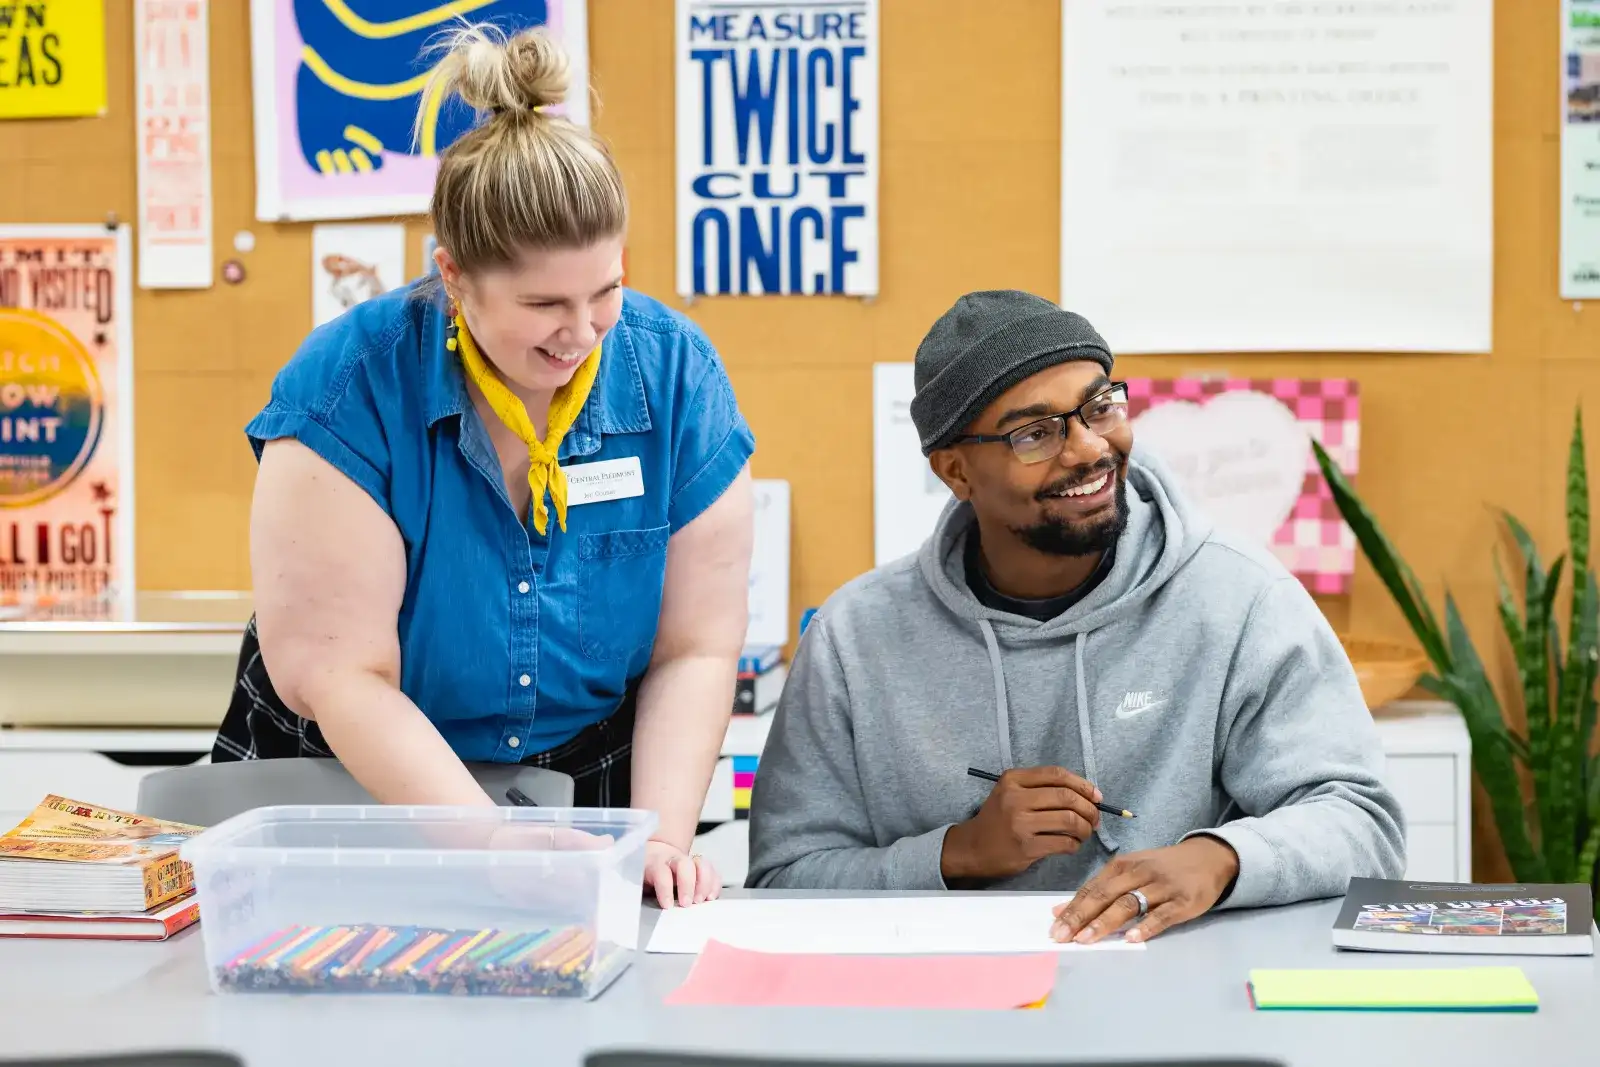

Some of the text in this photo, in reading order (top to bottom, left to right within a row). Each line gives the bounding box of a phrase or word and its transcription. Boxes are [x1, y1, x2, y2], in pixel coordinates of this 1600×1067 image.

[689, 12, 867, 42] MEASURE
[690, 46, 866, 167] TWICE
[692, 172, 865, 200] CUT
[692, 206, 865, 293] ONCE
[29, 268, 112, 324] VISITED
[1, 416, 61, 443] INT
[570, 474, 600, 484] CENTRAL
[601, 470, 636, 480] PIEDMONT
[37, 523, 50, 565] I
[61, 508, 115, 565] GOT
[1123, 691, 1153, 708] NIKE
[48, 801, 92, 818] WOOD
[1361, 902, 1439, 912] BITS
[1446, 897, 1565, 909] PAPER
